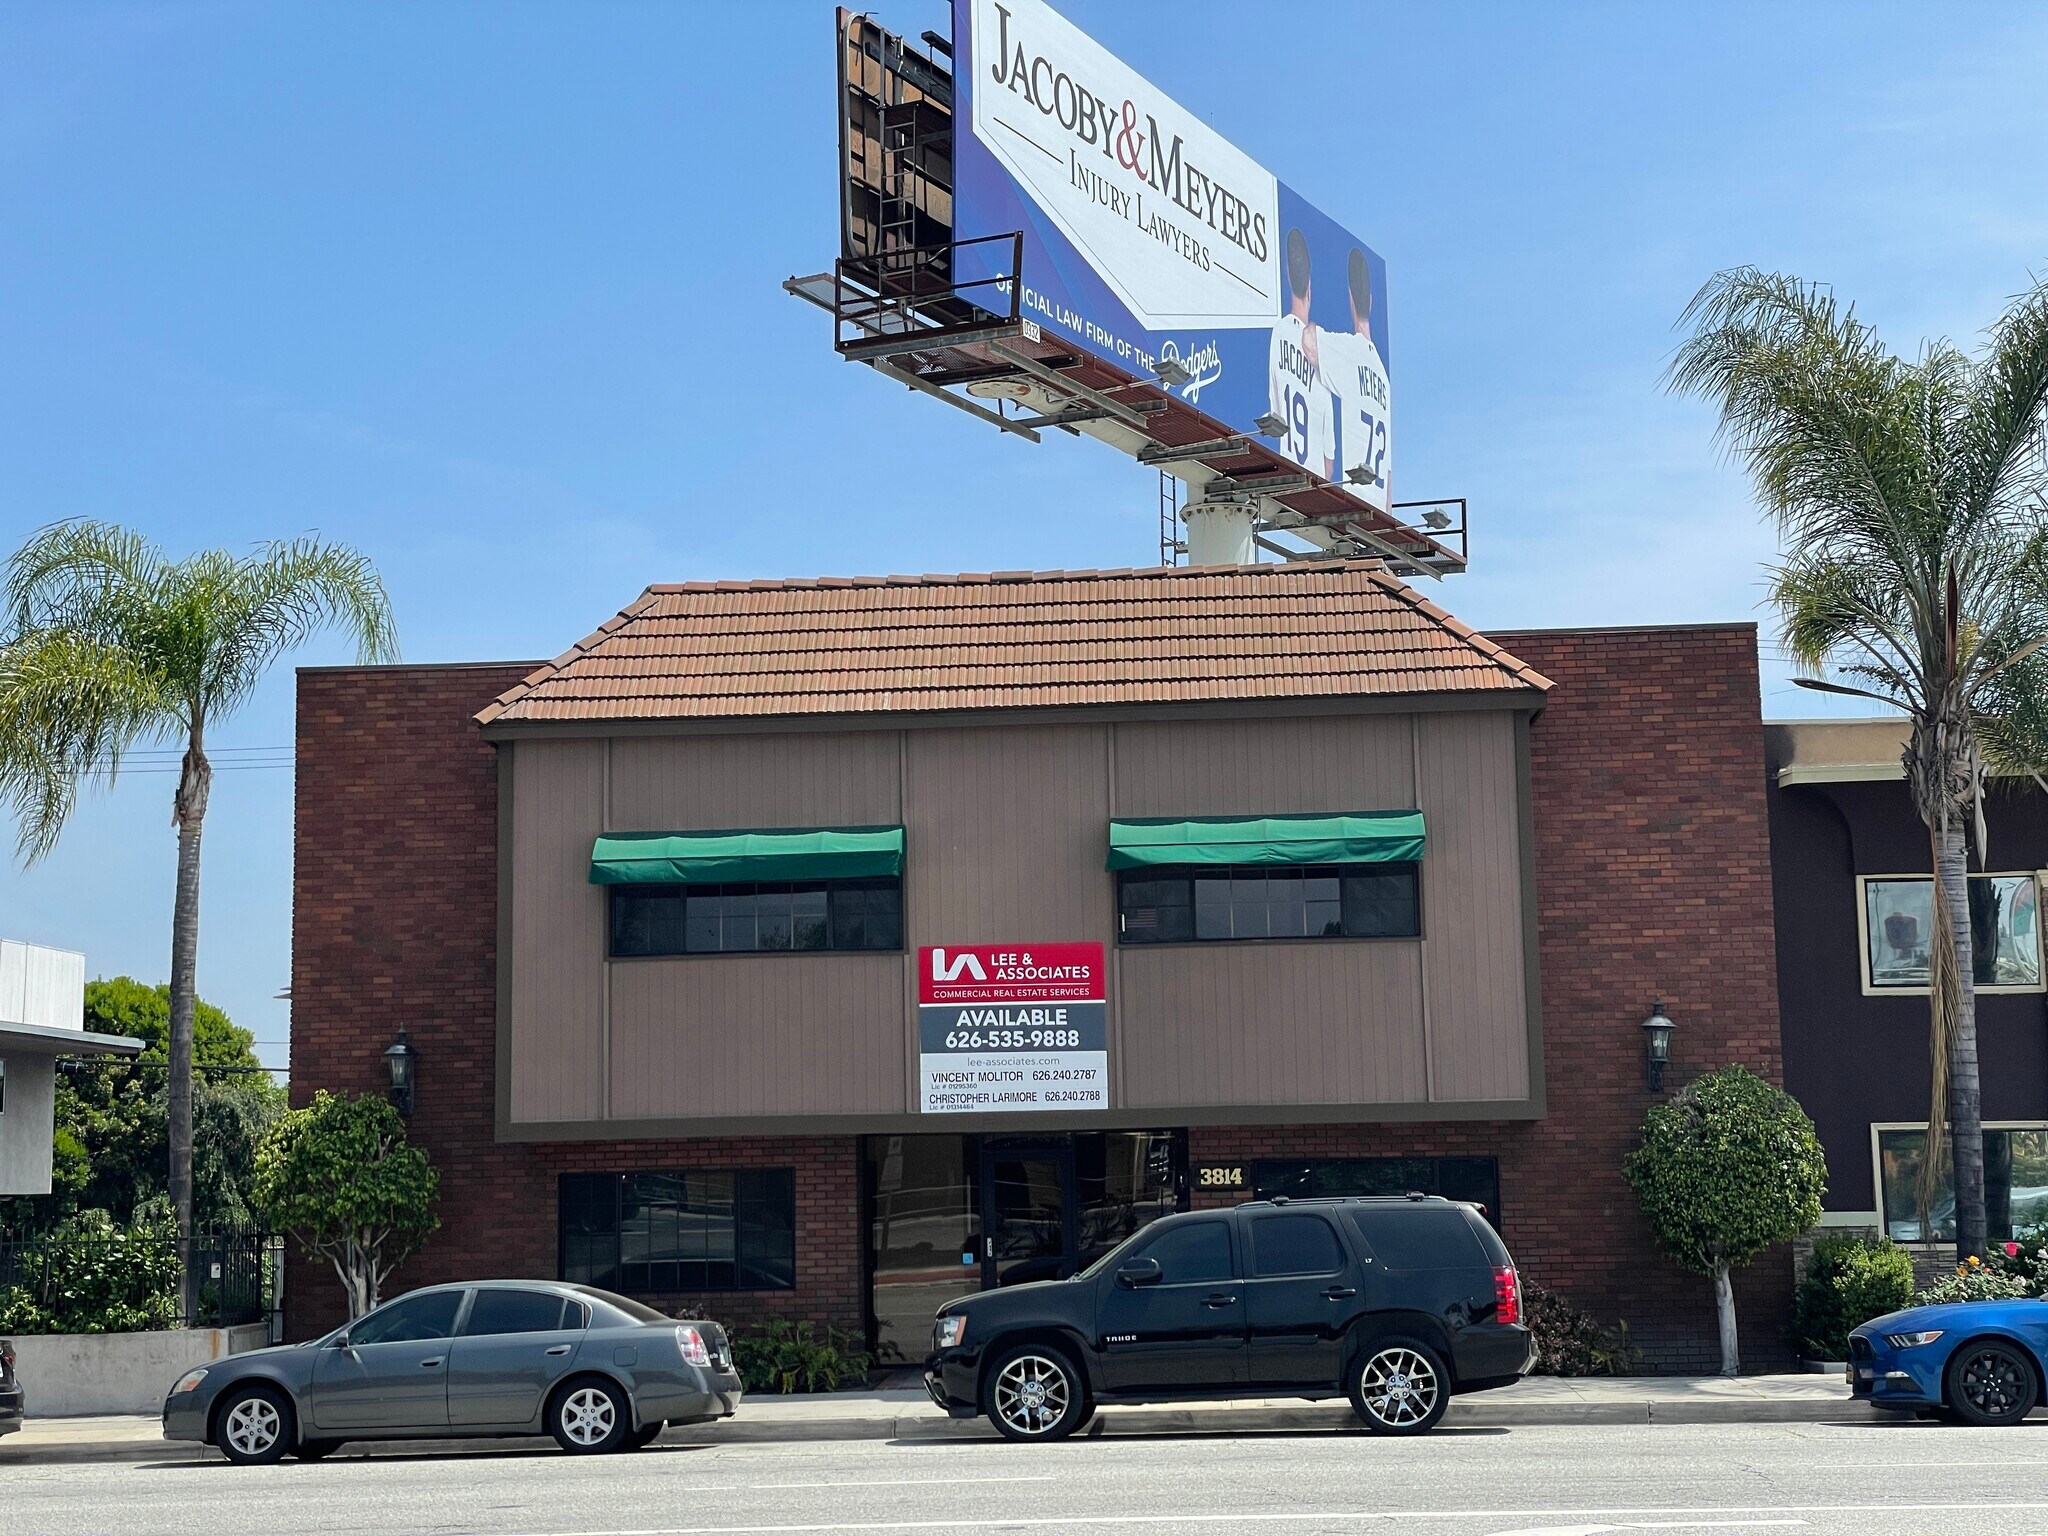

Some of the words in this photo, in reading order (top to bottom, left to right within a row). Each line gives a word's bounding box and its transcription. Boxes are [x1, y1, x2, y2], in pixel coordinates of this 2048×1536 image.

[1070, 148, 1131, 220] INJURY
[1136, 192, 1210, 272] LAWYERS
[995, 273, 1054, 318] OFICIAL
[1056, 304, 1082, 333] LAW
[1086, 321, 1114, 351] FIRM
[1117, 338, 1132, 359] OF
[1134, 347, 1157, 373] THE
[1278, 339, 1315, 392] JACOBY
[1357, 366, 1387, 411] MEYERS
[1284, 383, 1308, 465] 19
[1361, 409, 1386, 489] 72
[991, 953, 1017, 966] LEE
[1022, 953, 1033, 965] &
[996, 965, 1090, 980] ASSOCIATES
[933, 990, 991, 998] COMMERCIAL
[994, 989, 1015, 997] REAL
[1017, 988, 1047, 997] ESTATE
[1050, 988, 1090, 996] SERVICES
[956, 1009, 1068, 1026] AVAILABLE
[945, 1030, 1080, 1048] 626-535-9888
[967, 1057, 1060, 1067] lee-associates.com
[931, 1072, 975, 1082] VINCENT
[978, 1071, 1023, 1082] MOLITOR
[1032, 1069, 1097, 1081] 626.240.2787
[929, 1093, 990, 1104] CHRISTOPHER
[992, 1091, 1038, 1102] LARIMORE
[1045, 1090, 1101, 1101] 626.240.2788
[1200, 1168, 1242, 1185] 3814
